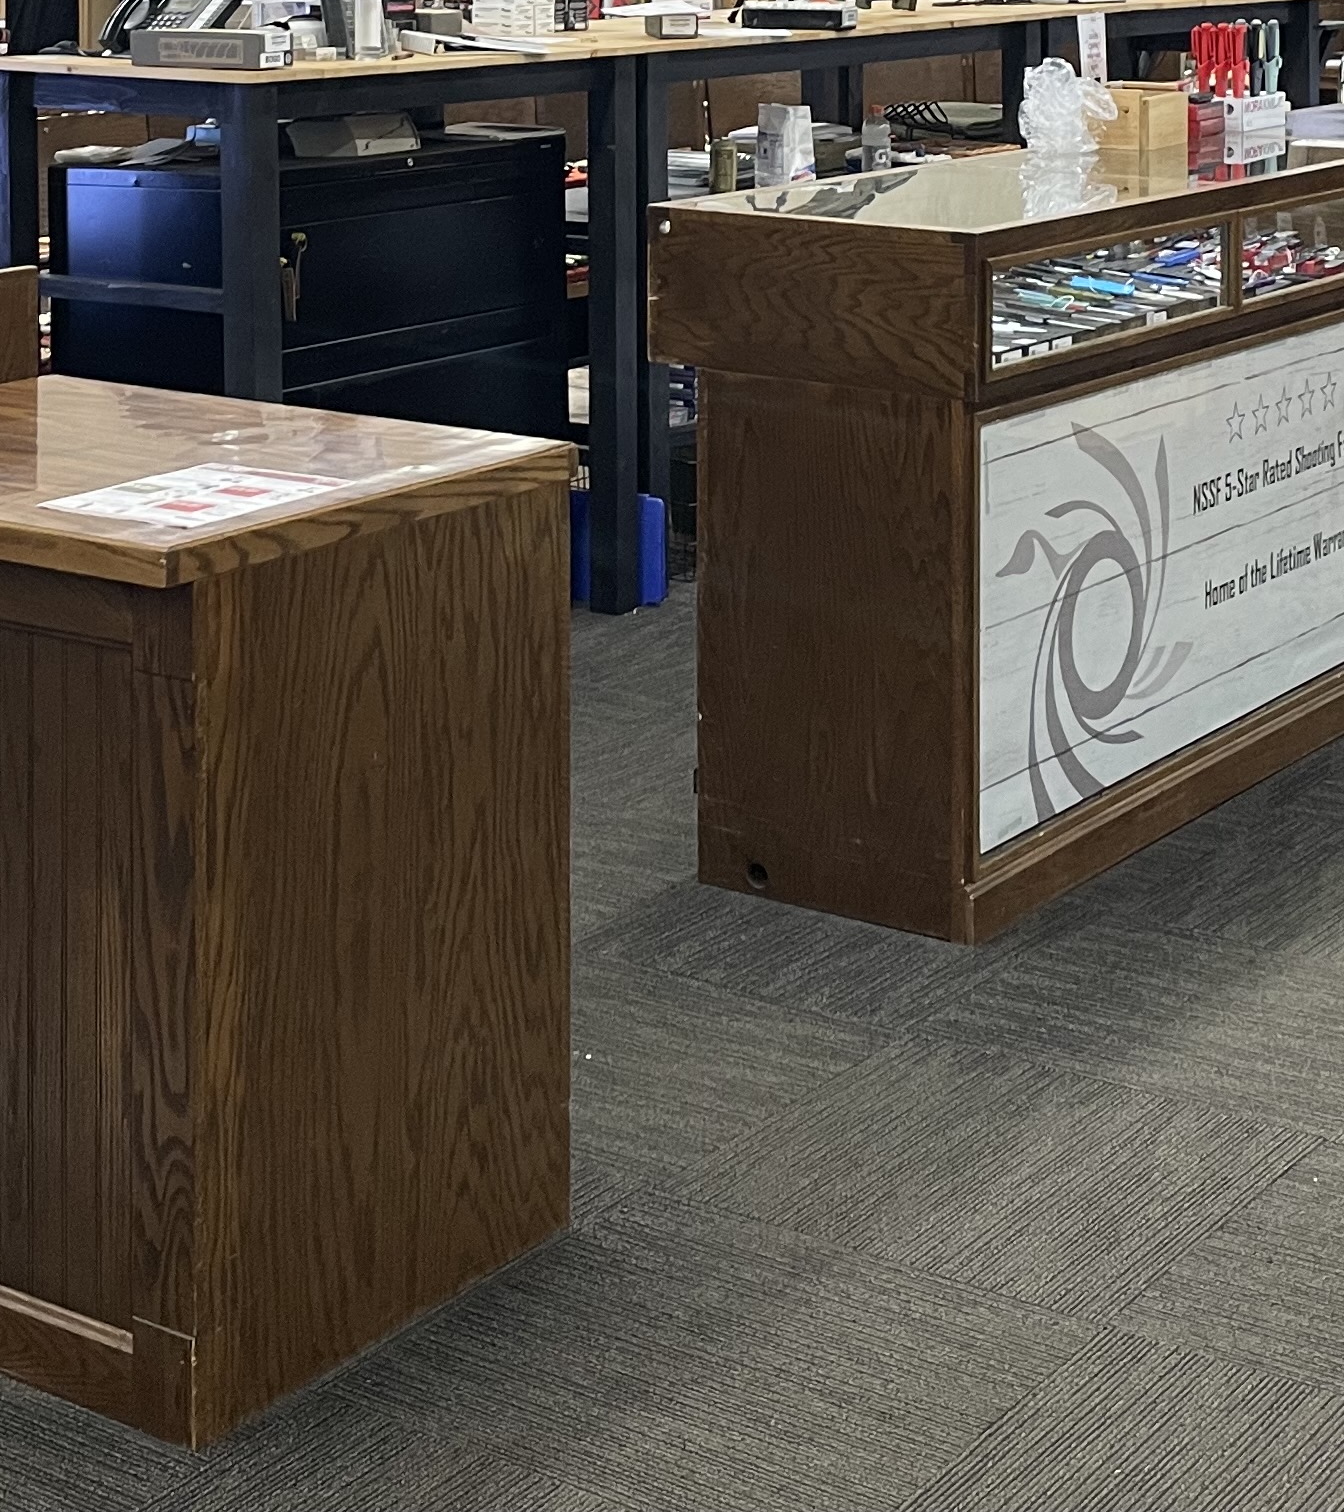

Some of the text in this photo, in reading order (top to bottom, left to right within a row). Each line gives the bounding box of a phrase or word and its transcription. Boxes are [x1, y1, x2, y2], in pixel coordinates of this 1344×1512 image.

[1193, 475, 1222, 516] NSSF
[1224, 467, 1259, 502] 5-Star
[1262, 449, 1292, 488] Rated
[1295, 439, 1336, 476] Shooting
[1205, 578, 1235, 610] Home
[1239, 562, 1248, 595] of
[1251, 558, 1267, 588] the
[1270, 545, 1311, 580] Lifetime
